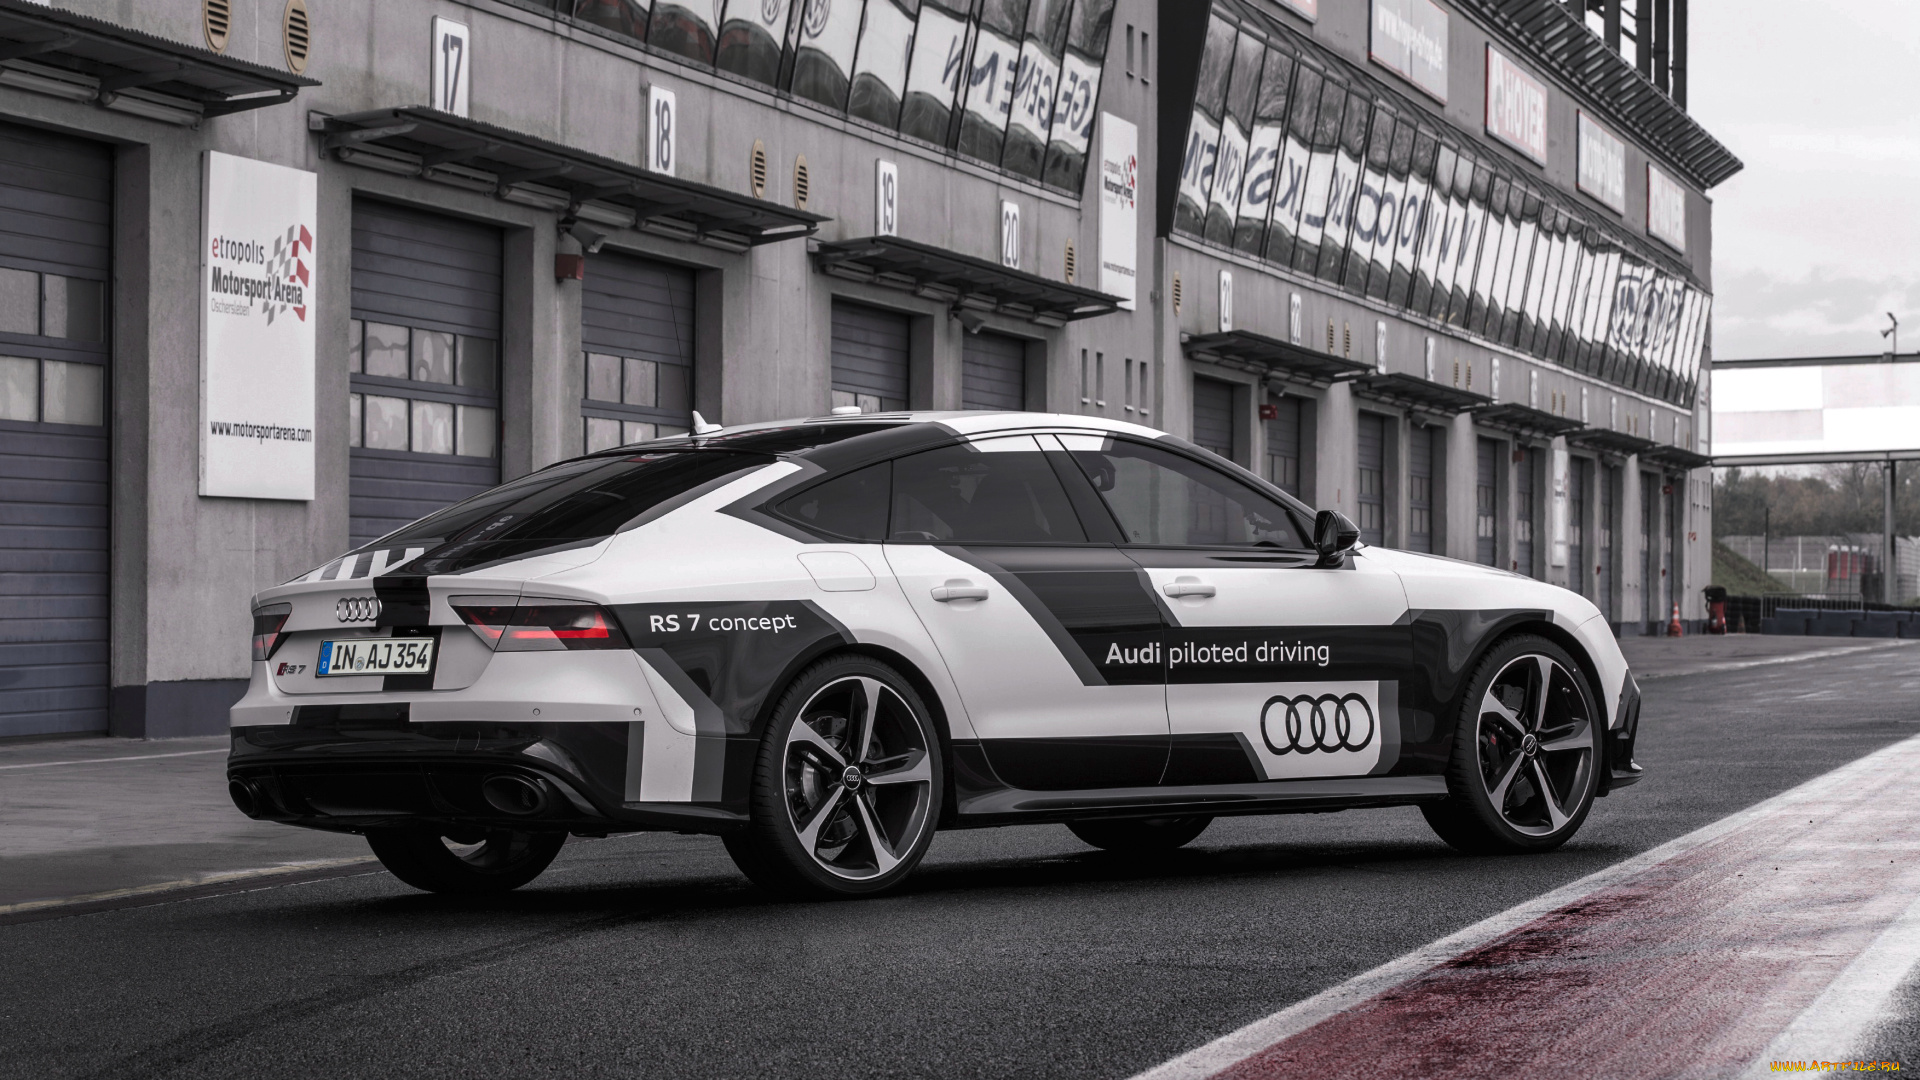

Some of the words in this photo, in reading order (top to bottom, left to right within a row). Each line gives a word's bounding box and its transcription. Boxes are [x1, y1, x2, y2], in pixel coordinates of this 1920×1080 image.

[443, 33, 462, 113] 17
[1505, 69, 1545, 155] HOYER
[655, 98, 671, 172] 18
[882, 171, 894, 233] 19
[211, 235, 265, 265] etropolis
[1004, 210, 1018, 267] 20
[211, 265, 272, 307] Motorsport
[273, 275, 303, 306] Arena
[211, 297, 251, 317] Oschersleben
[1222, 279, 1231, 325] 21
[210, 420, 313, 446] www.motorsportarena.com
[649, 613, 681, 633] RS
[686, 613, 701, 632] 7
[708, 613, 797, 634] concept
[331, 644, 357, 671] IN
[365, 643, 392, 670] AJ
[393, 642, 429, 669] 354
[1105, 642, 1161, 665] Audi
[1168, 641, 1248, 669] piloted
[1255, 640, 1330, 667] driving
